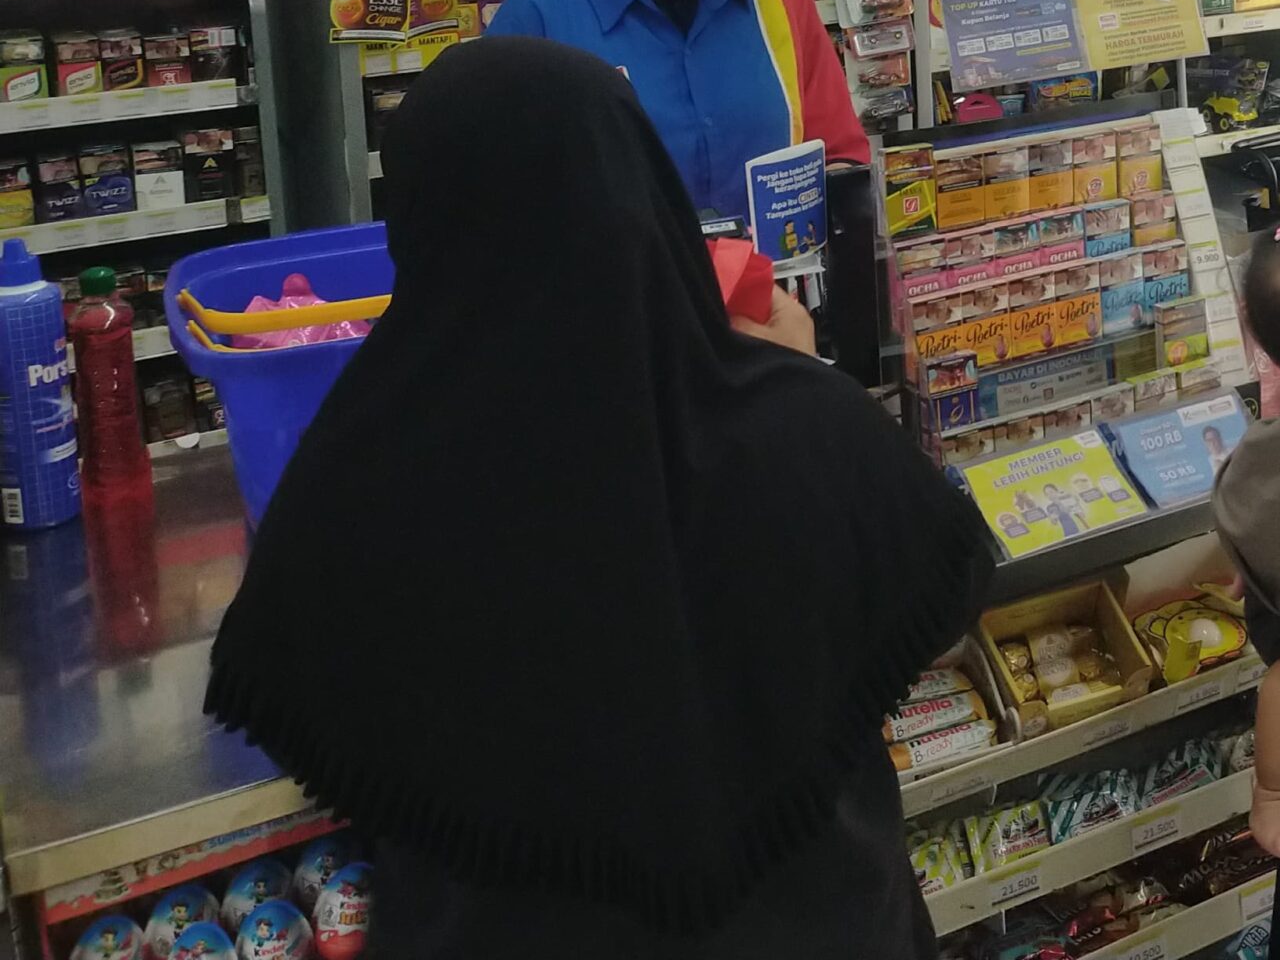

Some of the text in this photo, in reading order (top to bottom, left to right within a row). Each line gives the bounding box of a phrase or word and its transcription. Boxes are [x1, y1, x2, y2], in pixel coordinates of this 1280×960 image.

[368, 5, 402, 13] CHANGE
[365, 13, 401, 28] Cigar
[1138, 30, 1184, 45] TERMURAH
[91, 186, 126, 200] TWIZZ
[1050, 250, 1078, 263] OCHA
[1004, 261, 1033, 274] OCHA
[958, 271, 988, 285] OCHA
[908, 281, 940, 296] OCHA
[998, 364, 1035, 384] BAYAR
[1140, 430, 1182, 451] 100 RB
[1008, 447, 1061, 471] MEMBER
[994, 451, 1084, 489] LEBIH UNTUNG!
